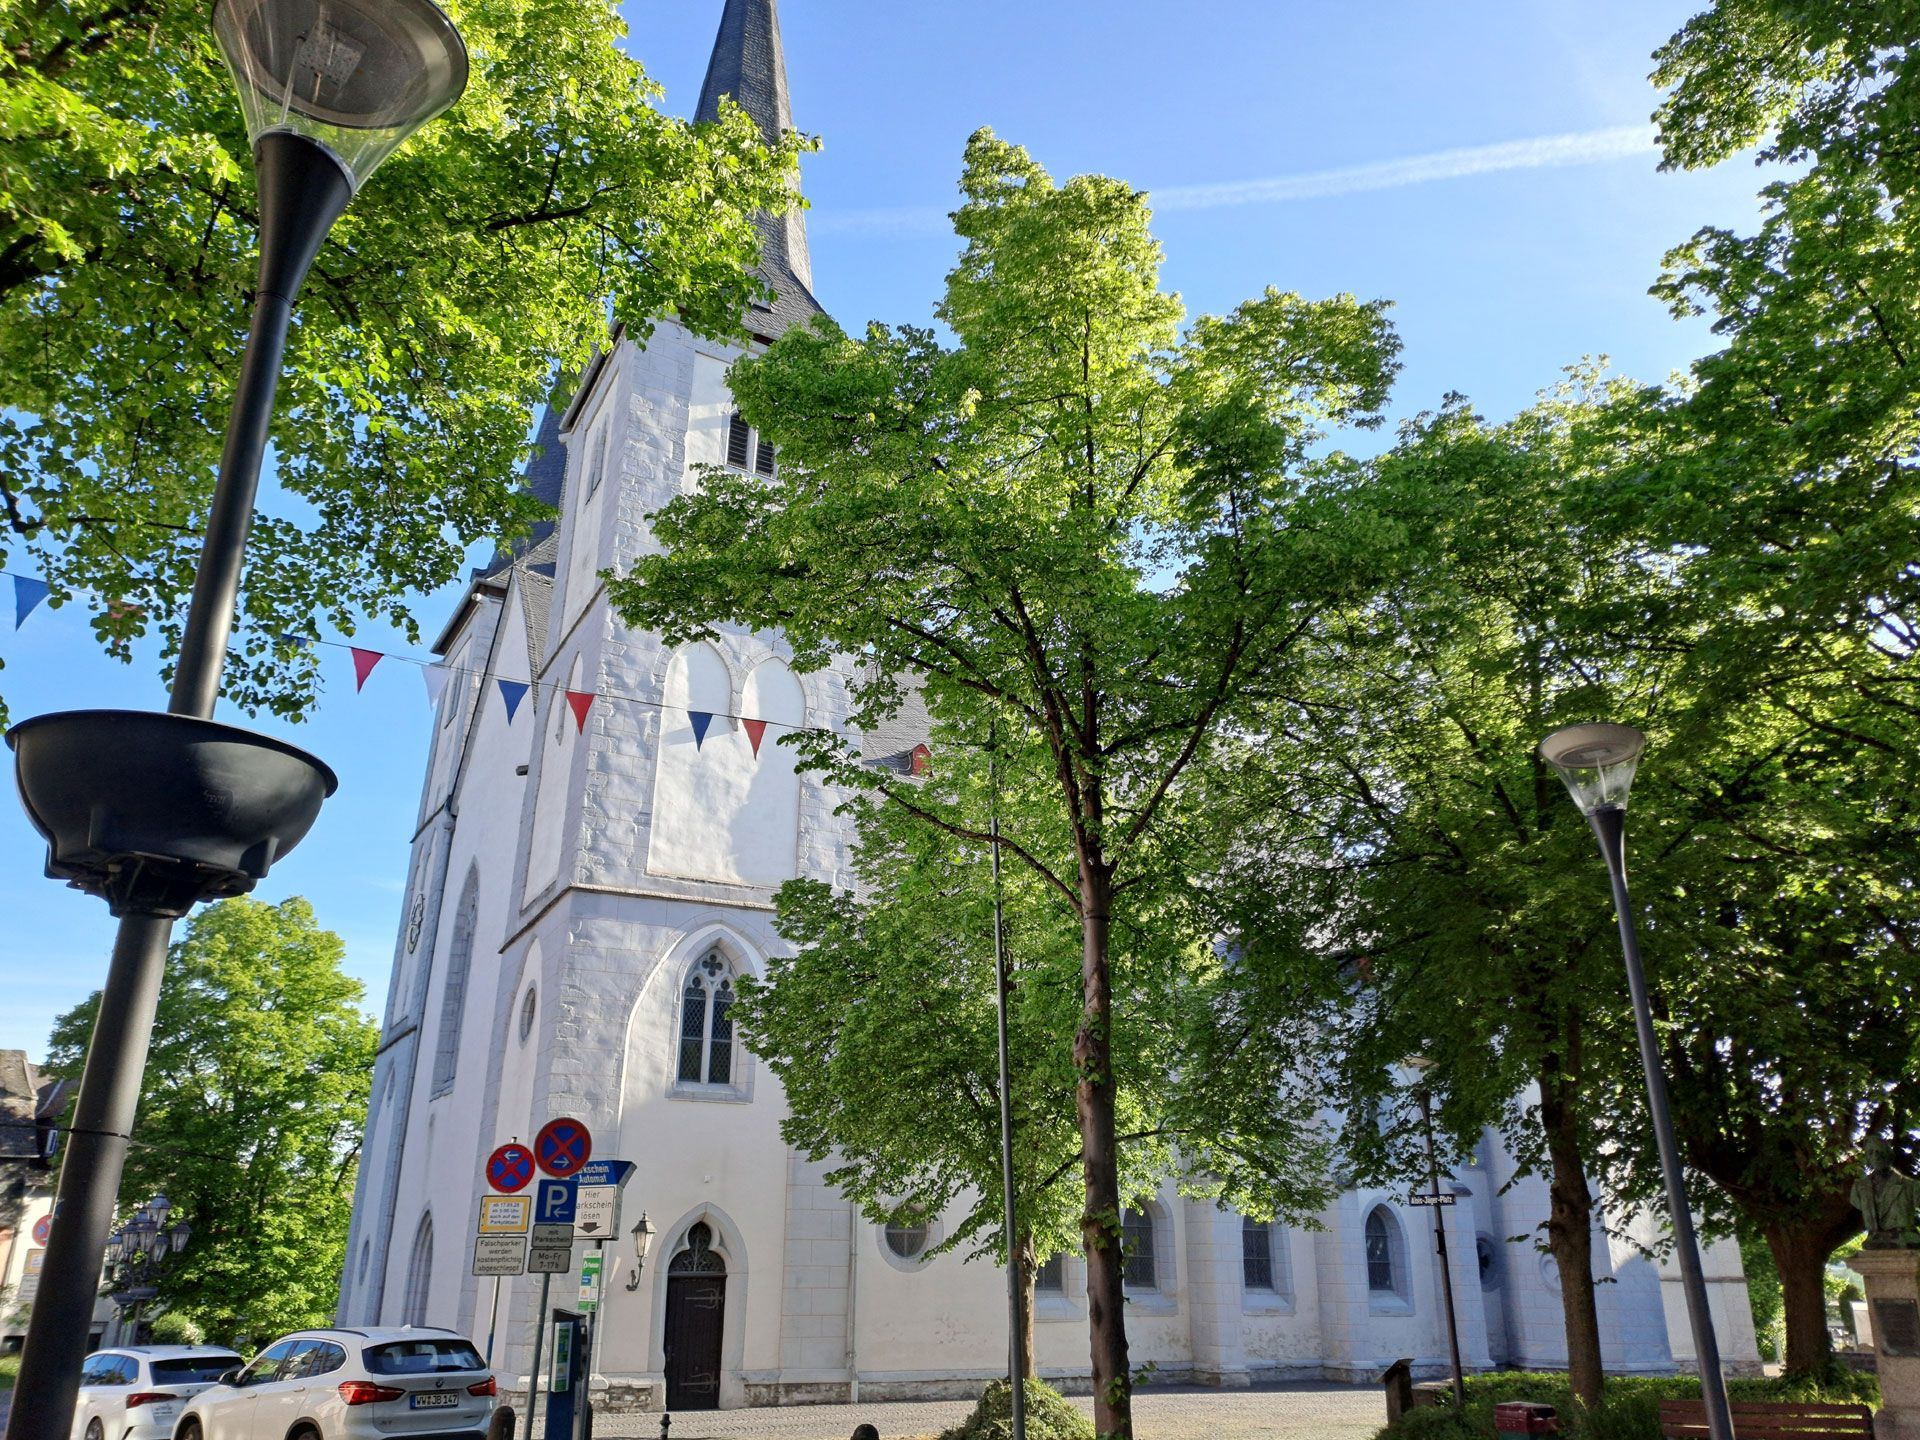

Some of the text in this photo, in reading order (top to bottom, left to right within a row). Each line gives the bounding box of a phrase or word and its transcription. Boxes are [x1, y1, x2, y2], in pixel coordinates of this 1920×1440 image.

[579, 1174, 607, 1184] Automat
[585, 1190, 600, 1198] Hier
[545, 1185, 568, 1217] P
[576, 1200, 612, 1210] arkschein
[581, 1211, 600, 1220] lösen
[480, 1239, 521, 1247] Falschparker
[477, 1256, 522, 1264] kostenpflichtig
[538, 1252, 562, 1261] Mo-Fr
[478, 1265, 519, 1273] abgeschleppt
